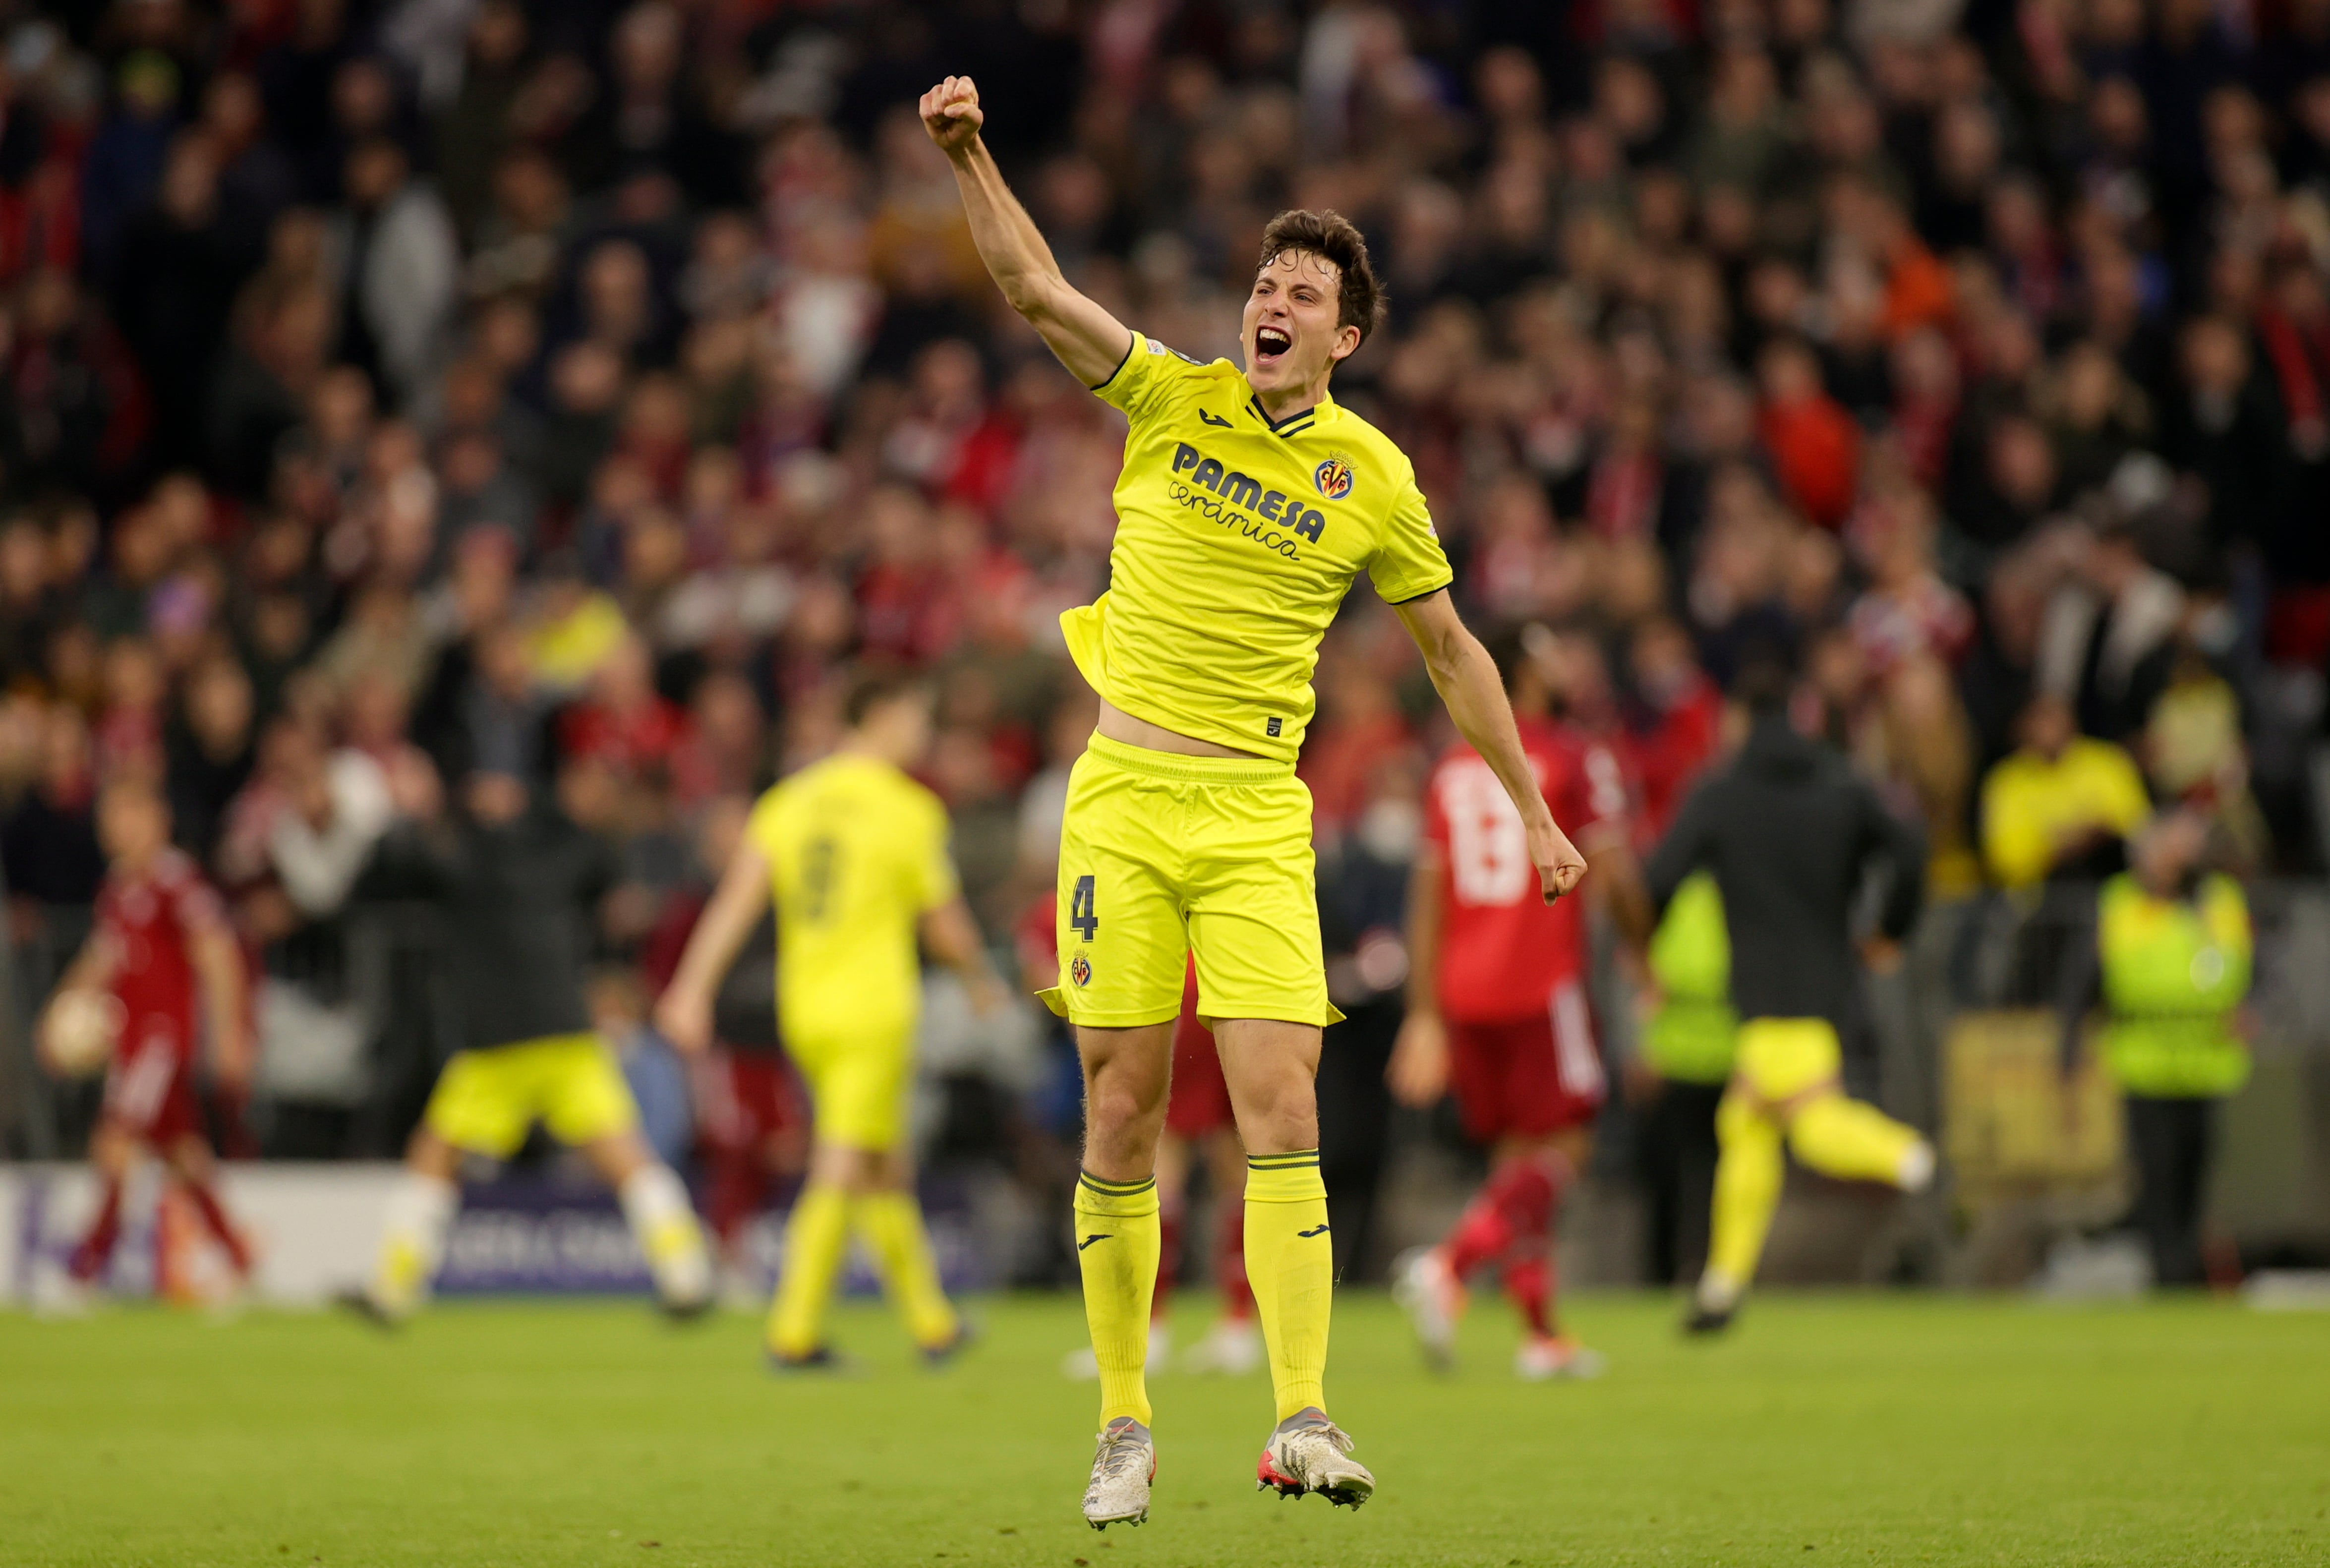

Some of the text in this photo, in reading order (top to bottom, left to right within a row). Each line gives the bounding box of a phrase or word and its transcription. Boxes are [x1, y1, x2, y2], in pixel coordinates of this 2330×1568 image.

[1168, 481, 1300, 561] cerámica
[1172, 442, 1326, 545] PAMESA
[1070, 875, 1099, 943] 4
